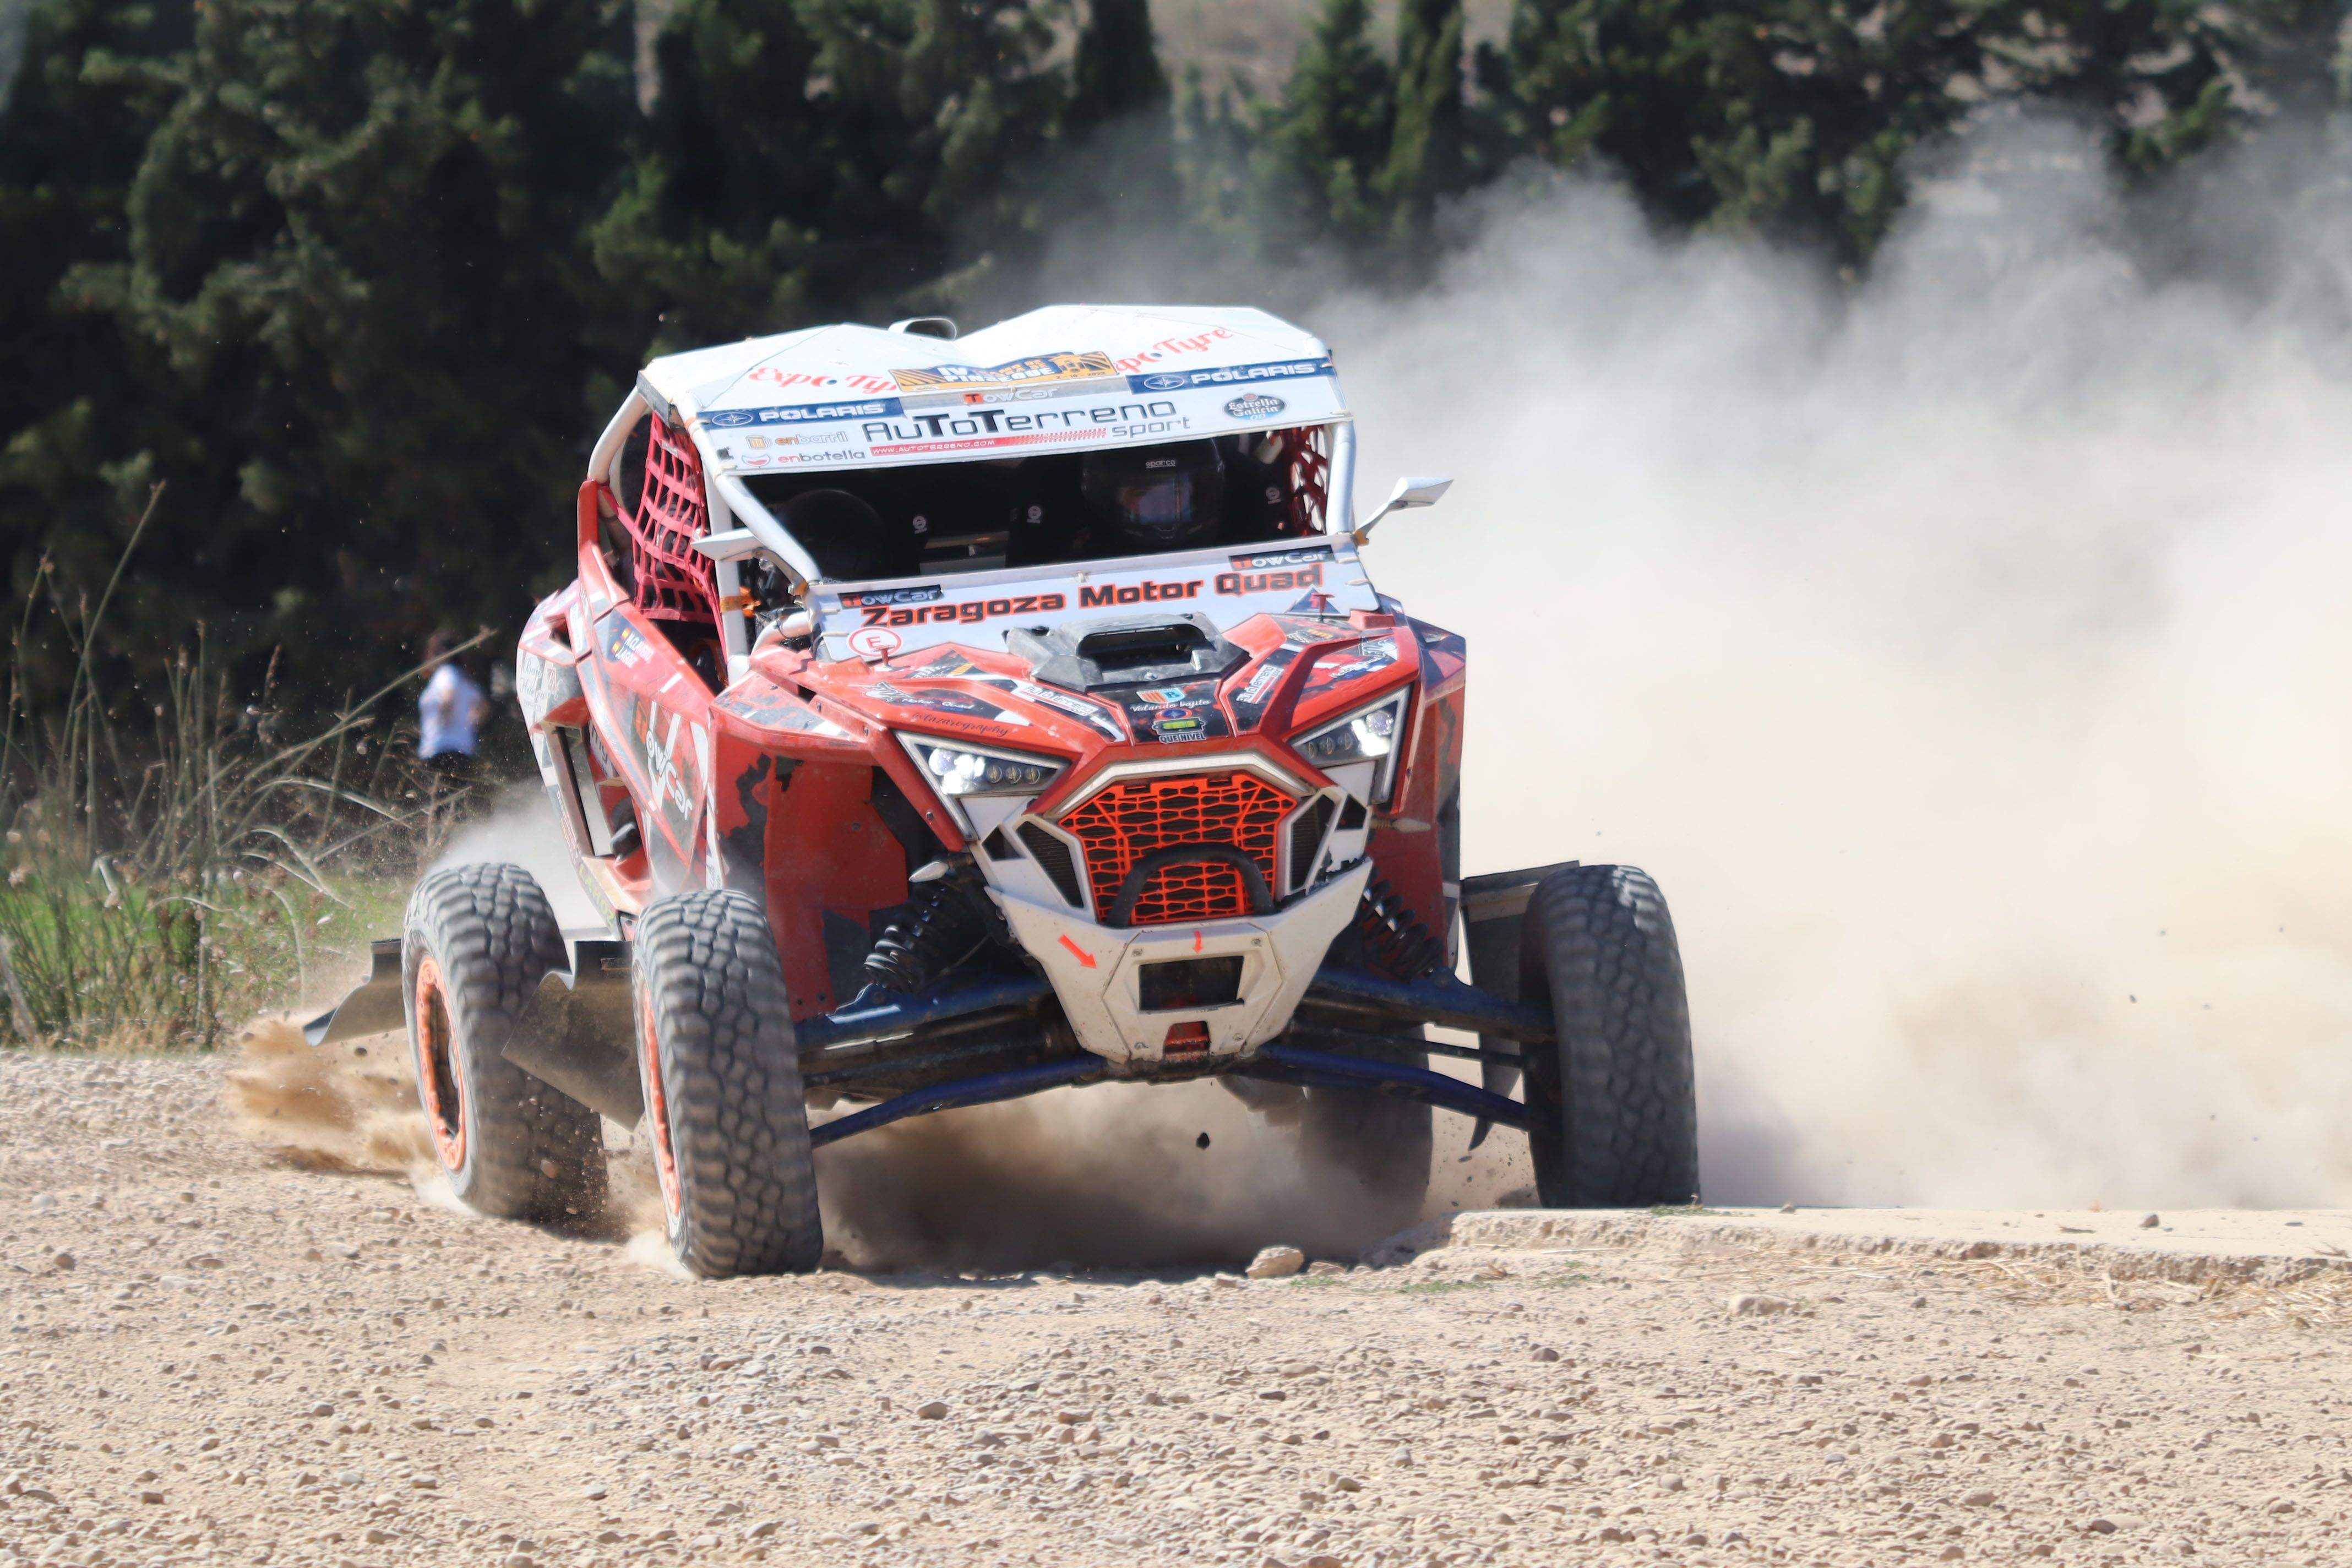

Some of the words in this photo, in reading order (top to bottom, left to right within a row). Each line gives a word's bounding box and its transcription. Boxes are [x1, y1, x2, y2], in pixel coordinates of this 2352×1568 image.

[749, 367, 837, 387] Expo
[937, 367, 968, 375] IV
[1190, 364, 1315, 384] POLARIS
[963, 386, 1059, 404] TowCar
[1228, 398, 1278, 410] Estrella
[759, 404, 884, 422] POLARIS
[1233, 406, 1278, 417] Galicia
[1111, 417, 1190, 438] sport
[775, 431, 849, 445] enbarril
[777, 450, 865, 463] enbotella
[841, 589, 938, 608] TowCar
[861, 592, 1067, 628] Zaragoza
[1078, 579, 1205, 608] Motor
[1213, 562, 1324, 598] Quad
[941, 701, 974, 710] Quad
[1130, 701, 1178, 712] Volando
[1179, 699, 1211, 709] bajito
[1159, 734, 1178, 743] QUE
[1180, 733, 1206, 742] NIVEL
